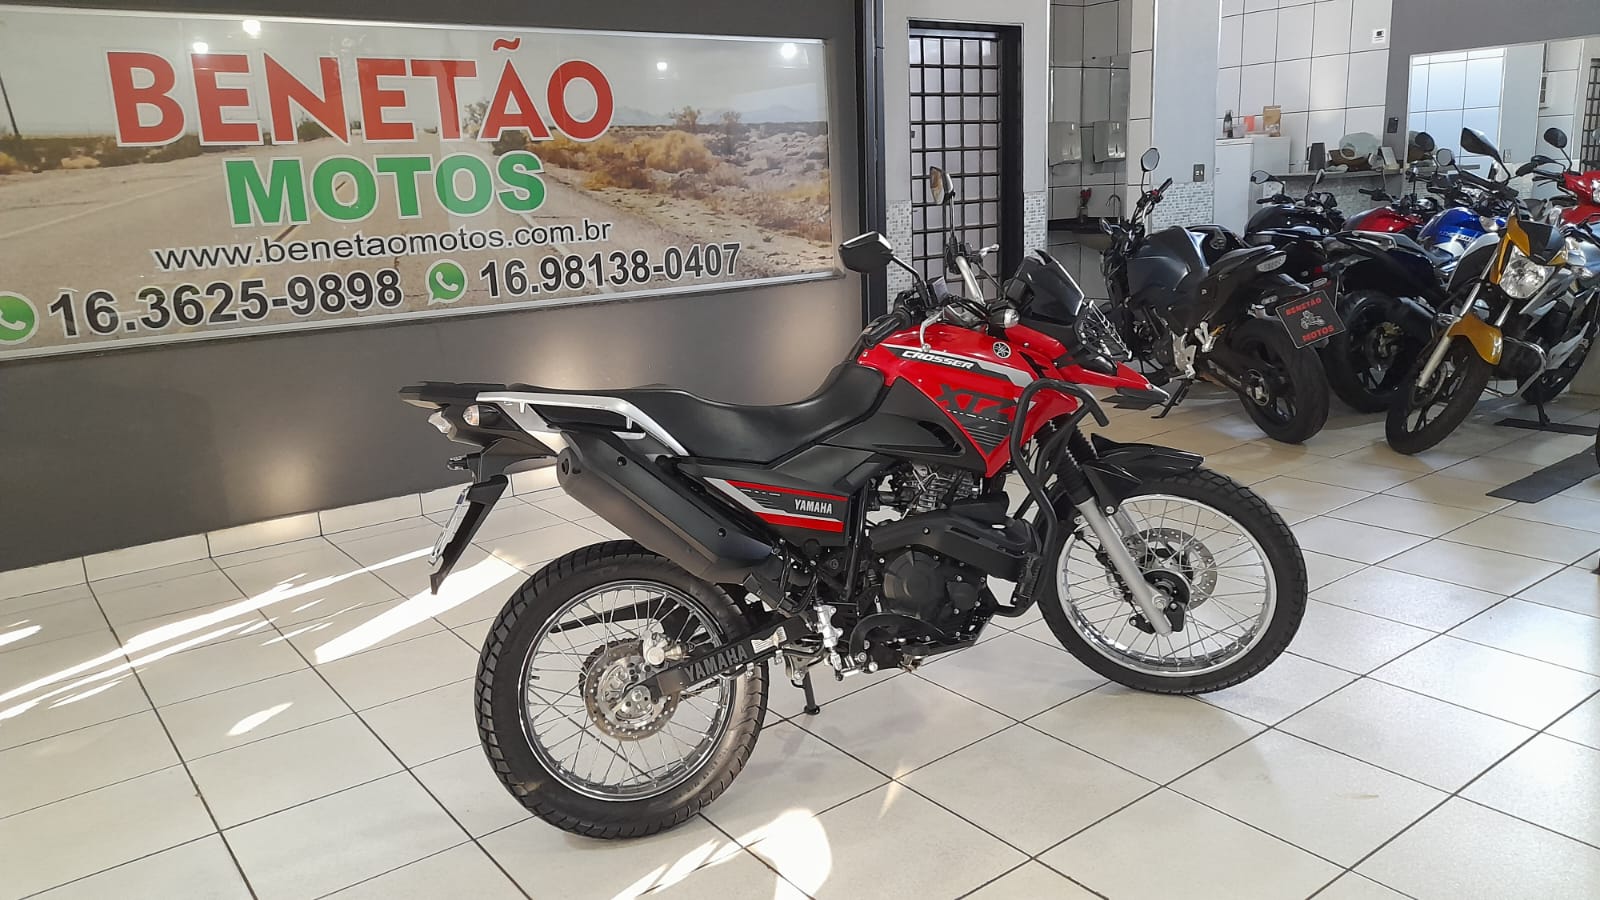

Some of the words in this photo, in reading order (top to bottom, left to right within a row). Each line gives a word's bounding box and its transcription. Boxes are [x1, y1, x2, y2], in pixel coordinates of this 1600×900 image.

[106, 38, 613, 146] BENETÃO
[224, 153, 546, 226] MOTOS
[154, 219, 611, 270] www.benetaomotos.com.br
[480, 243, 741, 298] 16.98138-0407
[50, 269, 402, 337] 16.3625-9898
[1302, 325, 1335, 342] MOTOS
[902, 350, 974, 370] CROSSER
[936, 384, 1019, 419] XTZ
[794, 498, 833, 515] YAMAHA
[684, 644, 749, 682] YAMAHA
